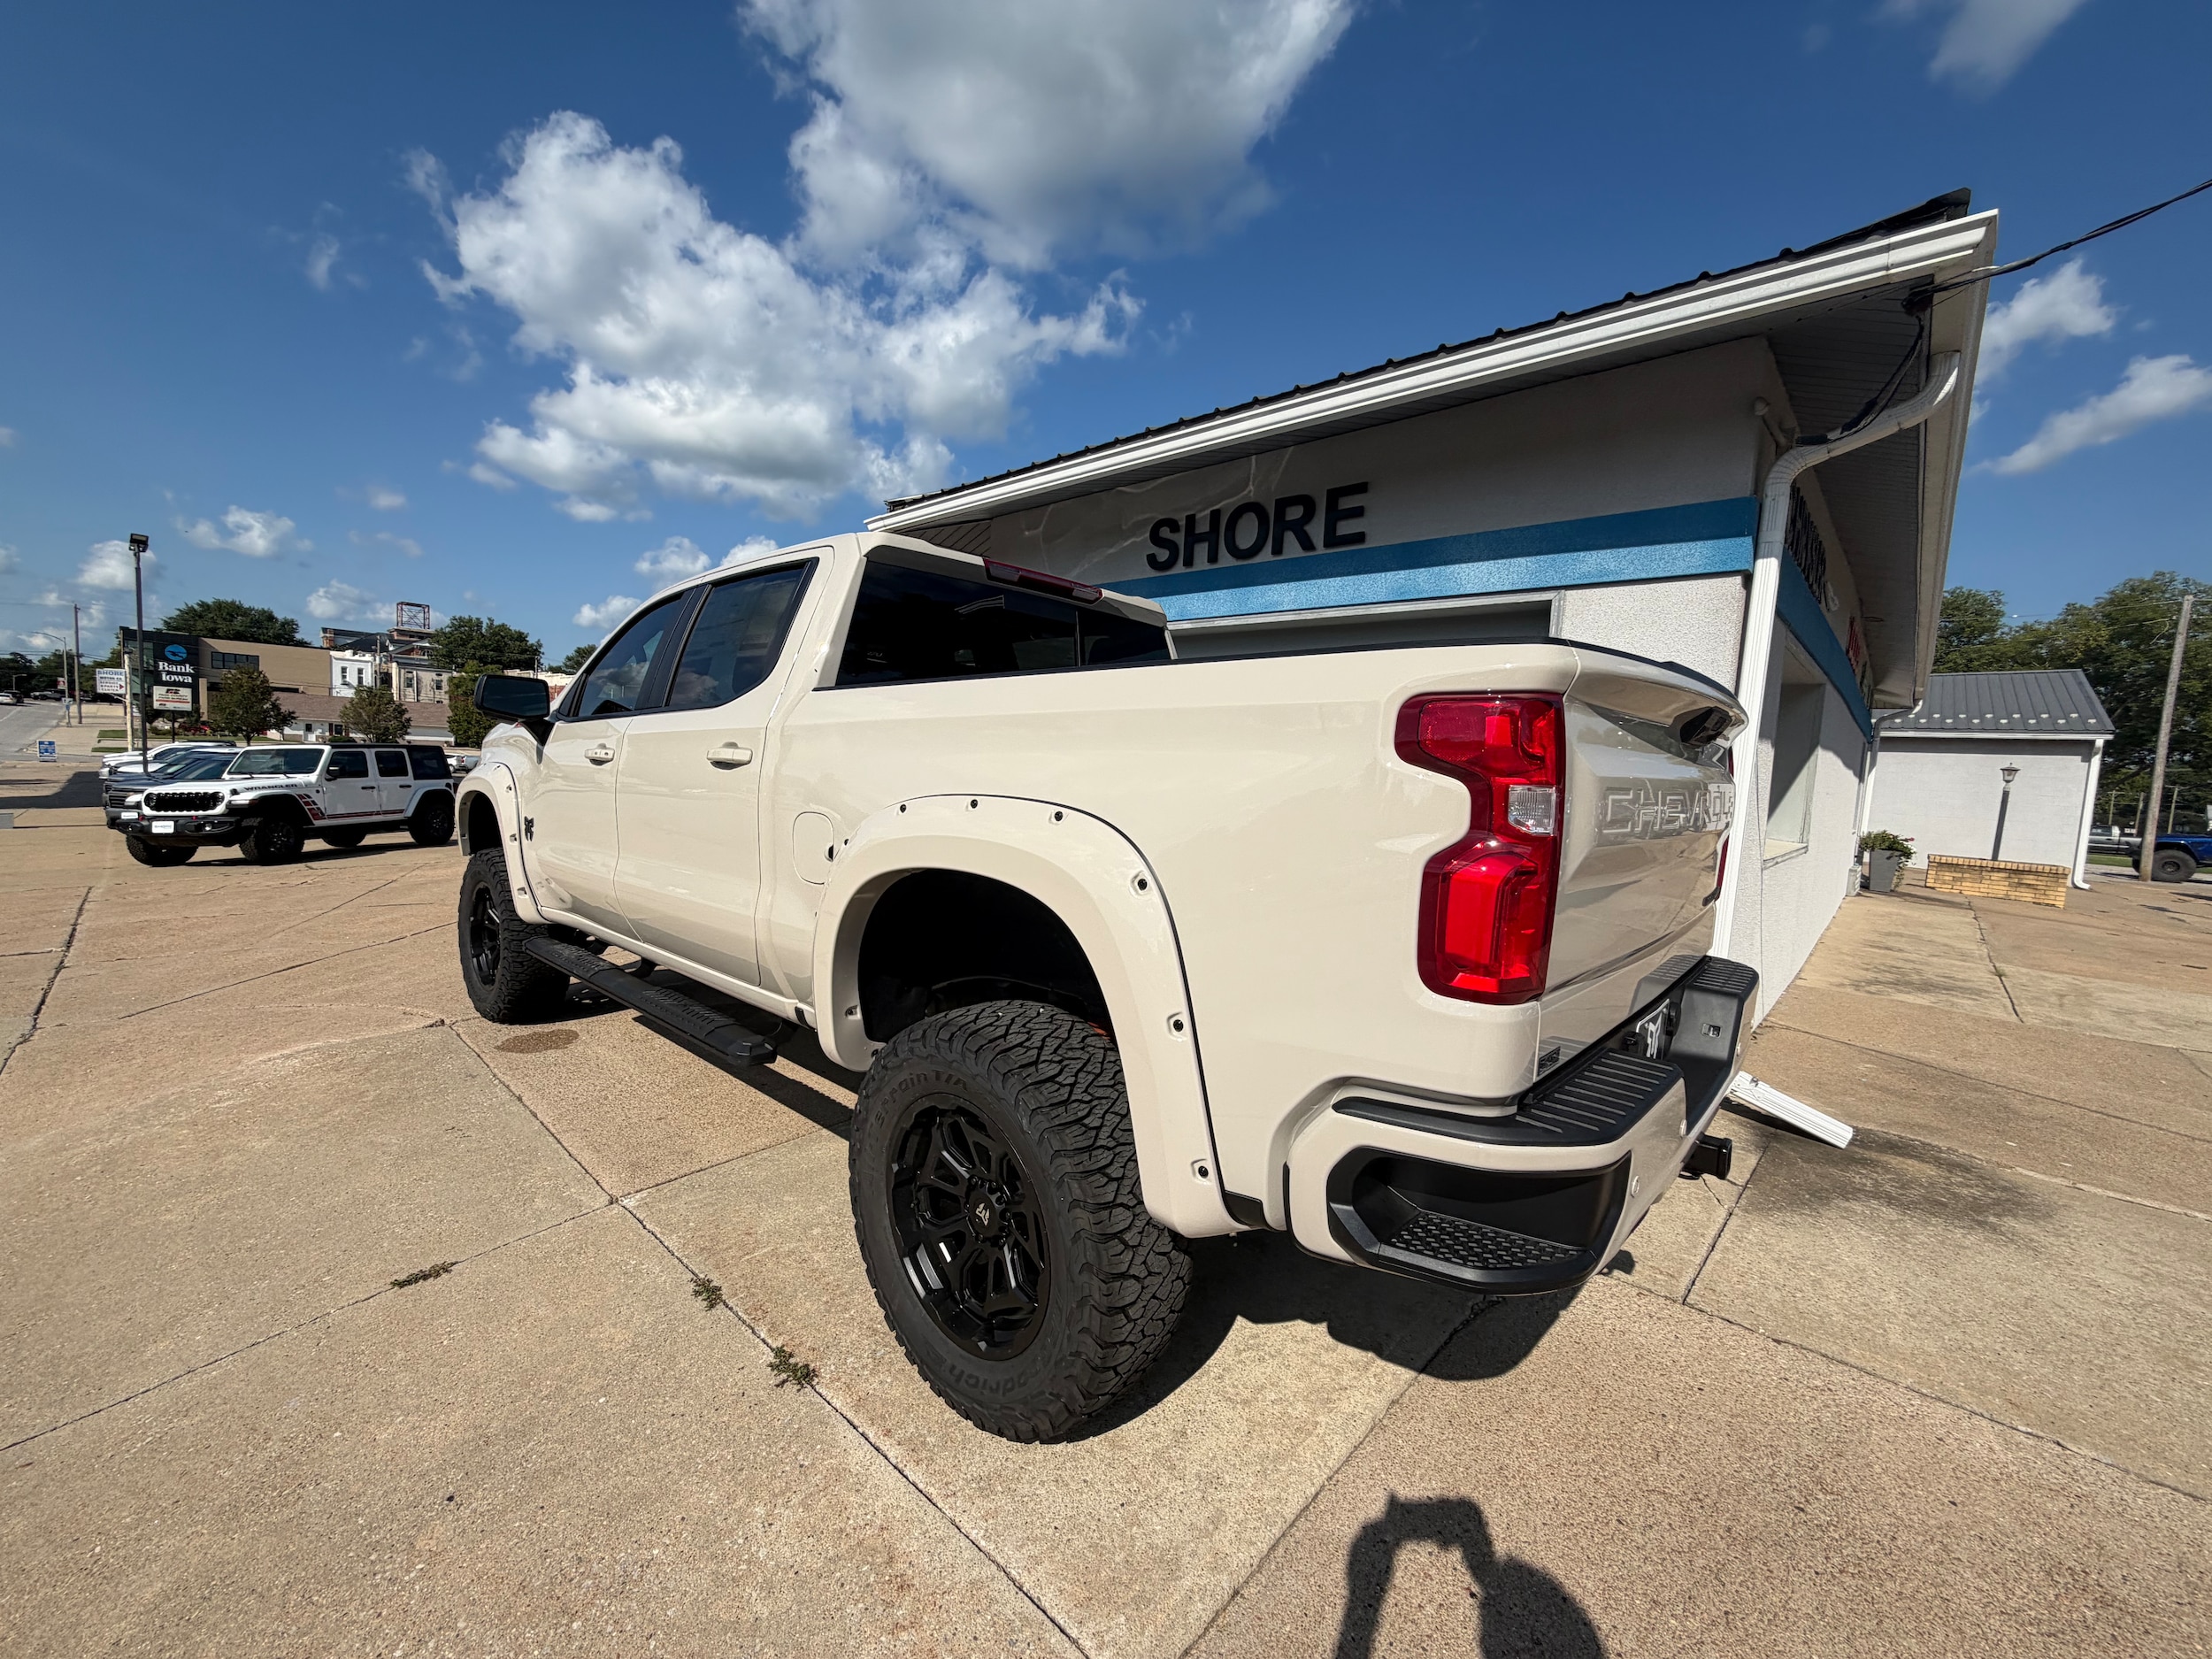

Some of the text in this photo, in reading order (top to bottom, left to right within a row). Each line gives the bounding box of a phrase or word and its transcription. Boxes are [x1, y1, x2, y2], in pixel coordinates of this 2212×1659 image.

[1146, 481, 1369, 572] SHORE
[157, 662, 195, 673] Bank
[161, 672, 193, 683] Iowa
[1601, 787, 1734, 834] CHEVROLE
